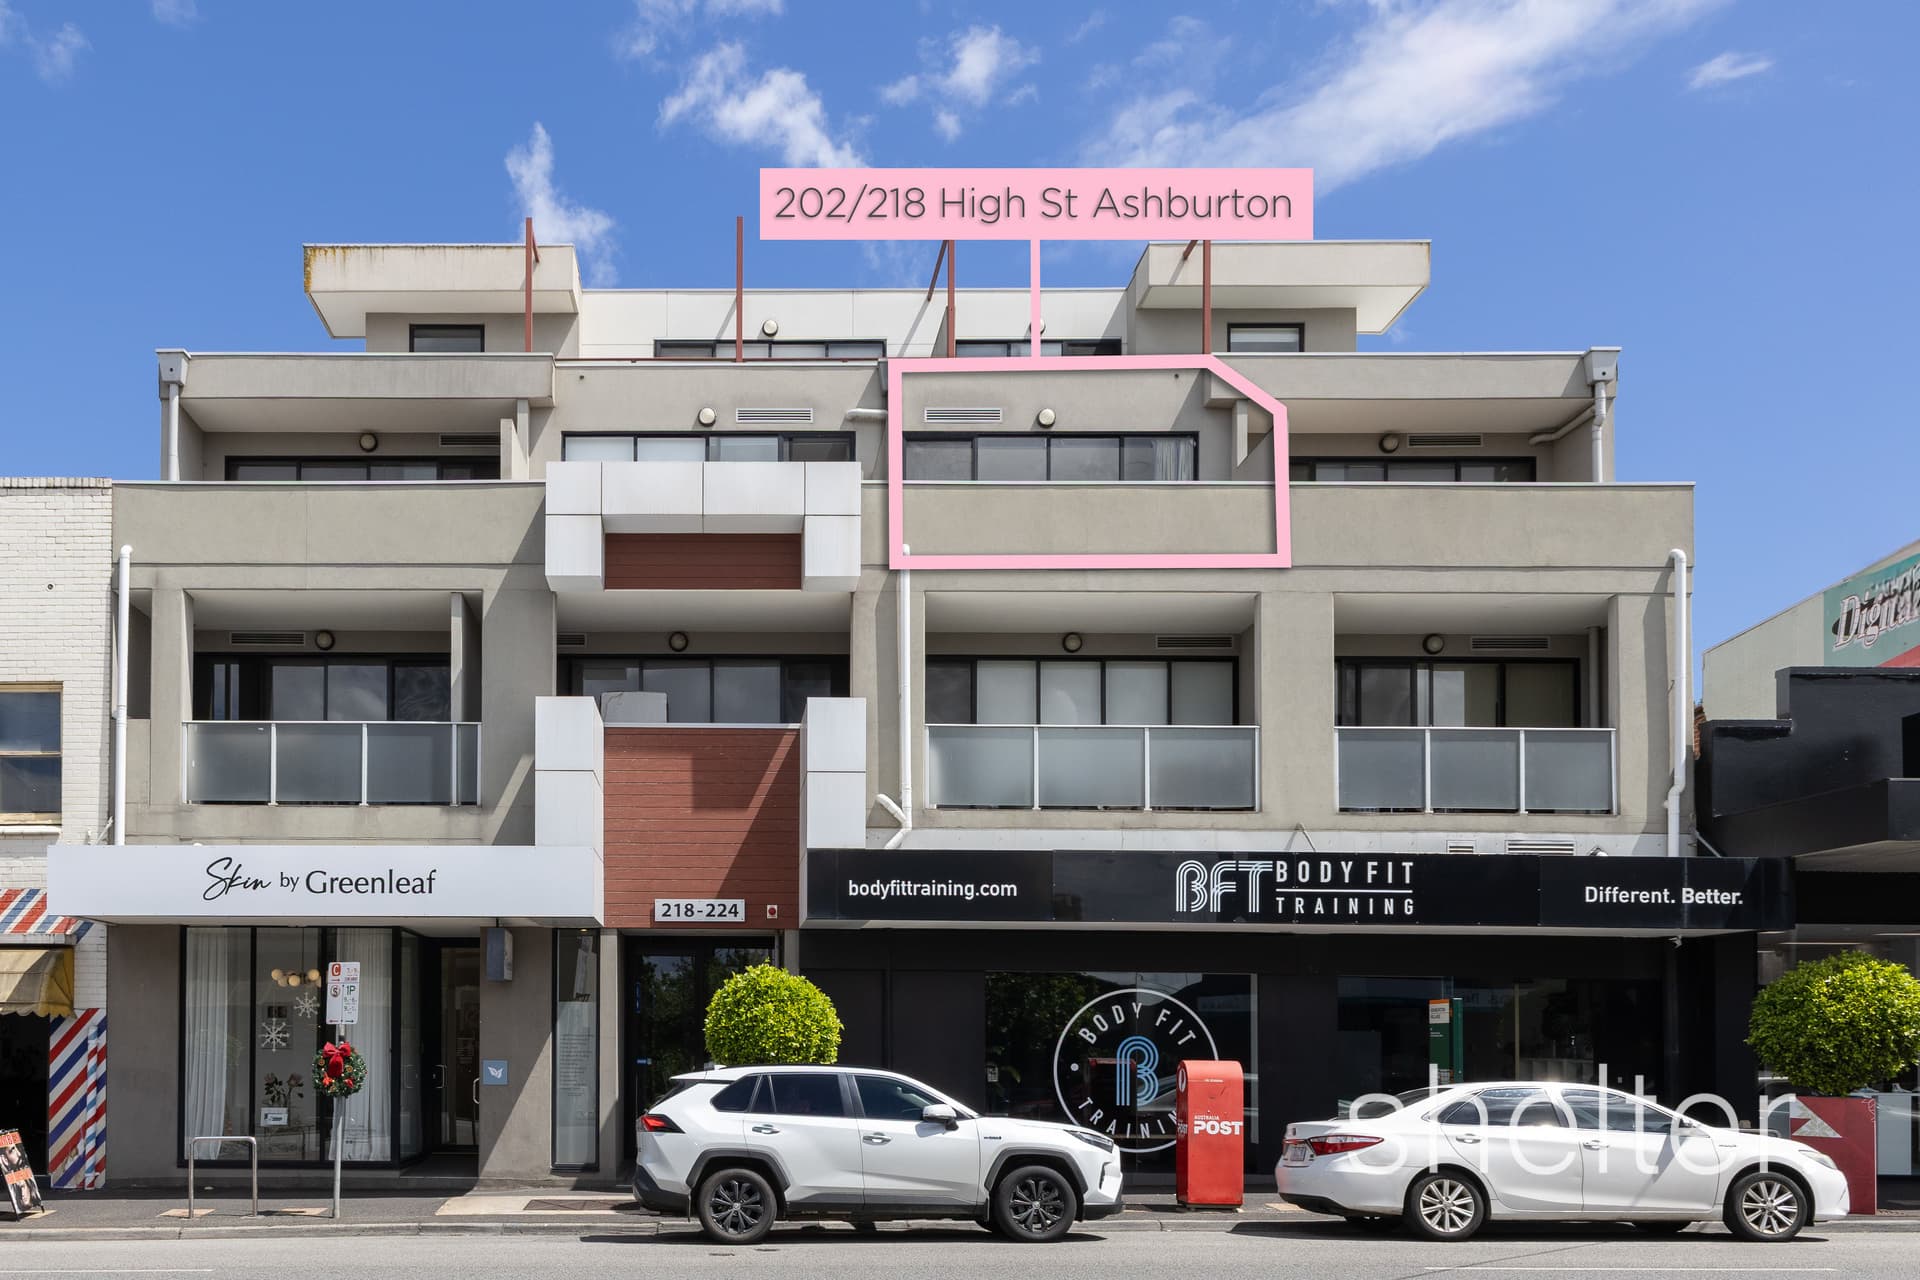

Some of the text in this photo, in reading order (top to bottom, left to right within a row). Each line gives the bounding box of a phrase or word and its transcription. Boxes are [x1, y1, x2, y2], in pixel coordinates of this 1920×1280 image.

[203, 857, 436, 900] Skin by Greenleaf
[1276, 860, 1413, 884] BODY FIT
[848, 880, 1018, 900] bodyfittraining.com
[1176, 860, 1273, 912] BFT
[1585, 886, 1743, 905] Different. Better.
[661, 903, 739, 918] 218-224
[1276, 897, 1414, 915] TRAINING
[1079, 1002, 1196, 1046] BODY FIT
[1078, 1096, 1176, 1139] TRAININ
[1193, 1121, 1244, 1135] POST
